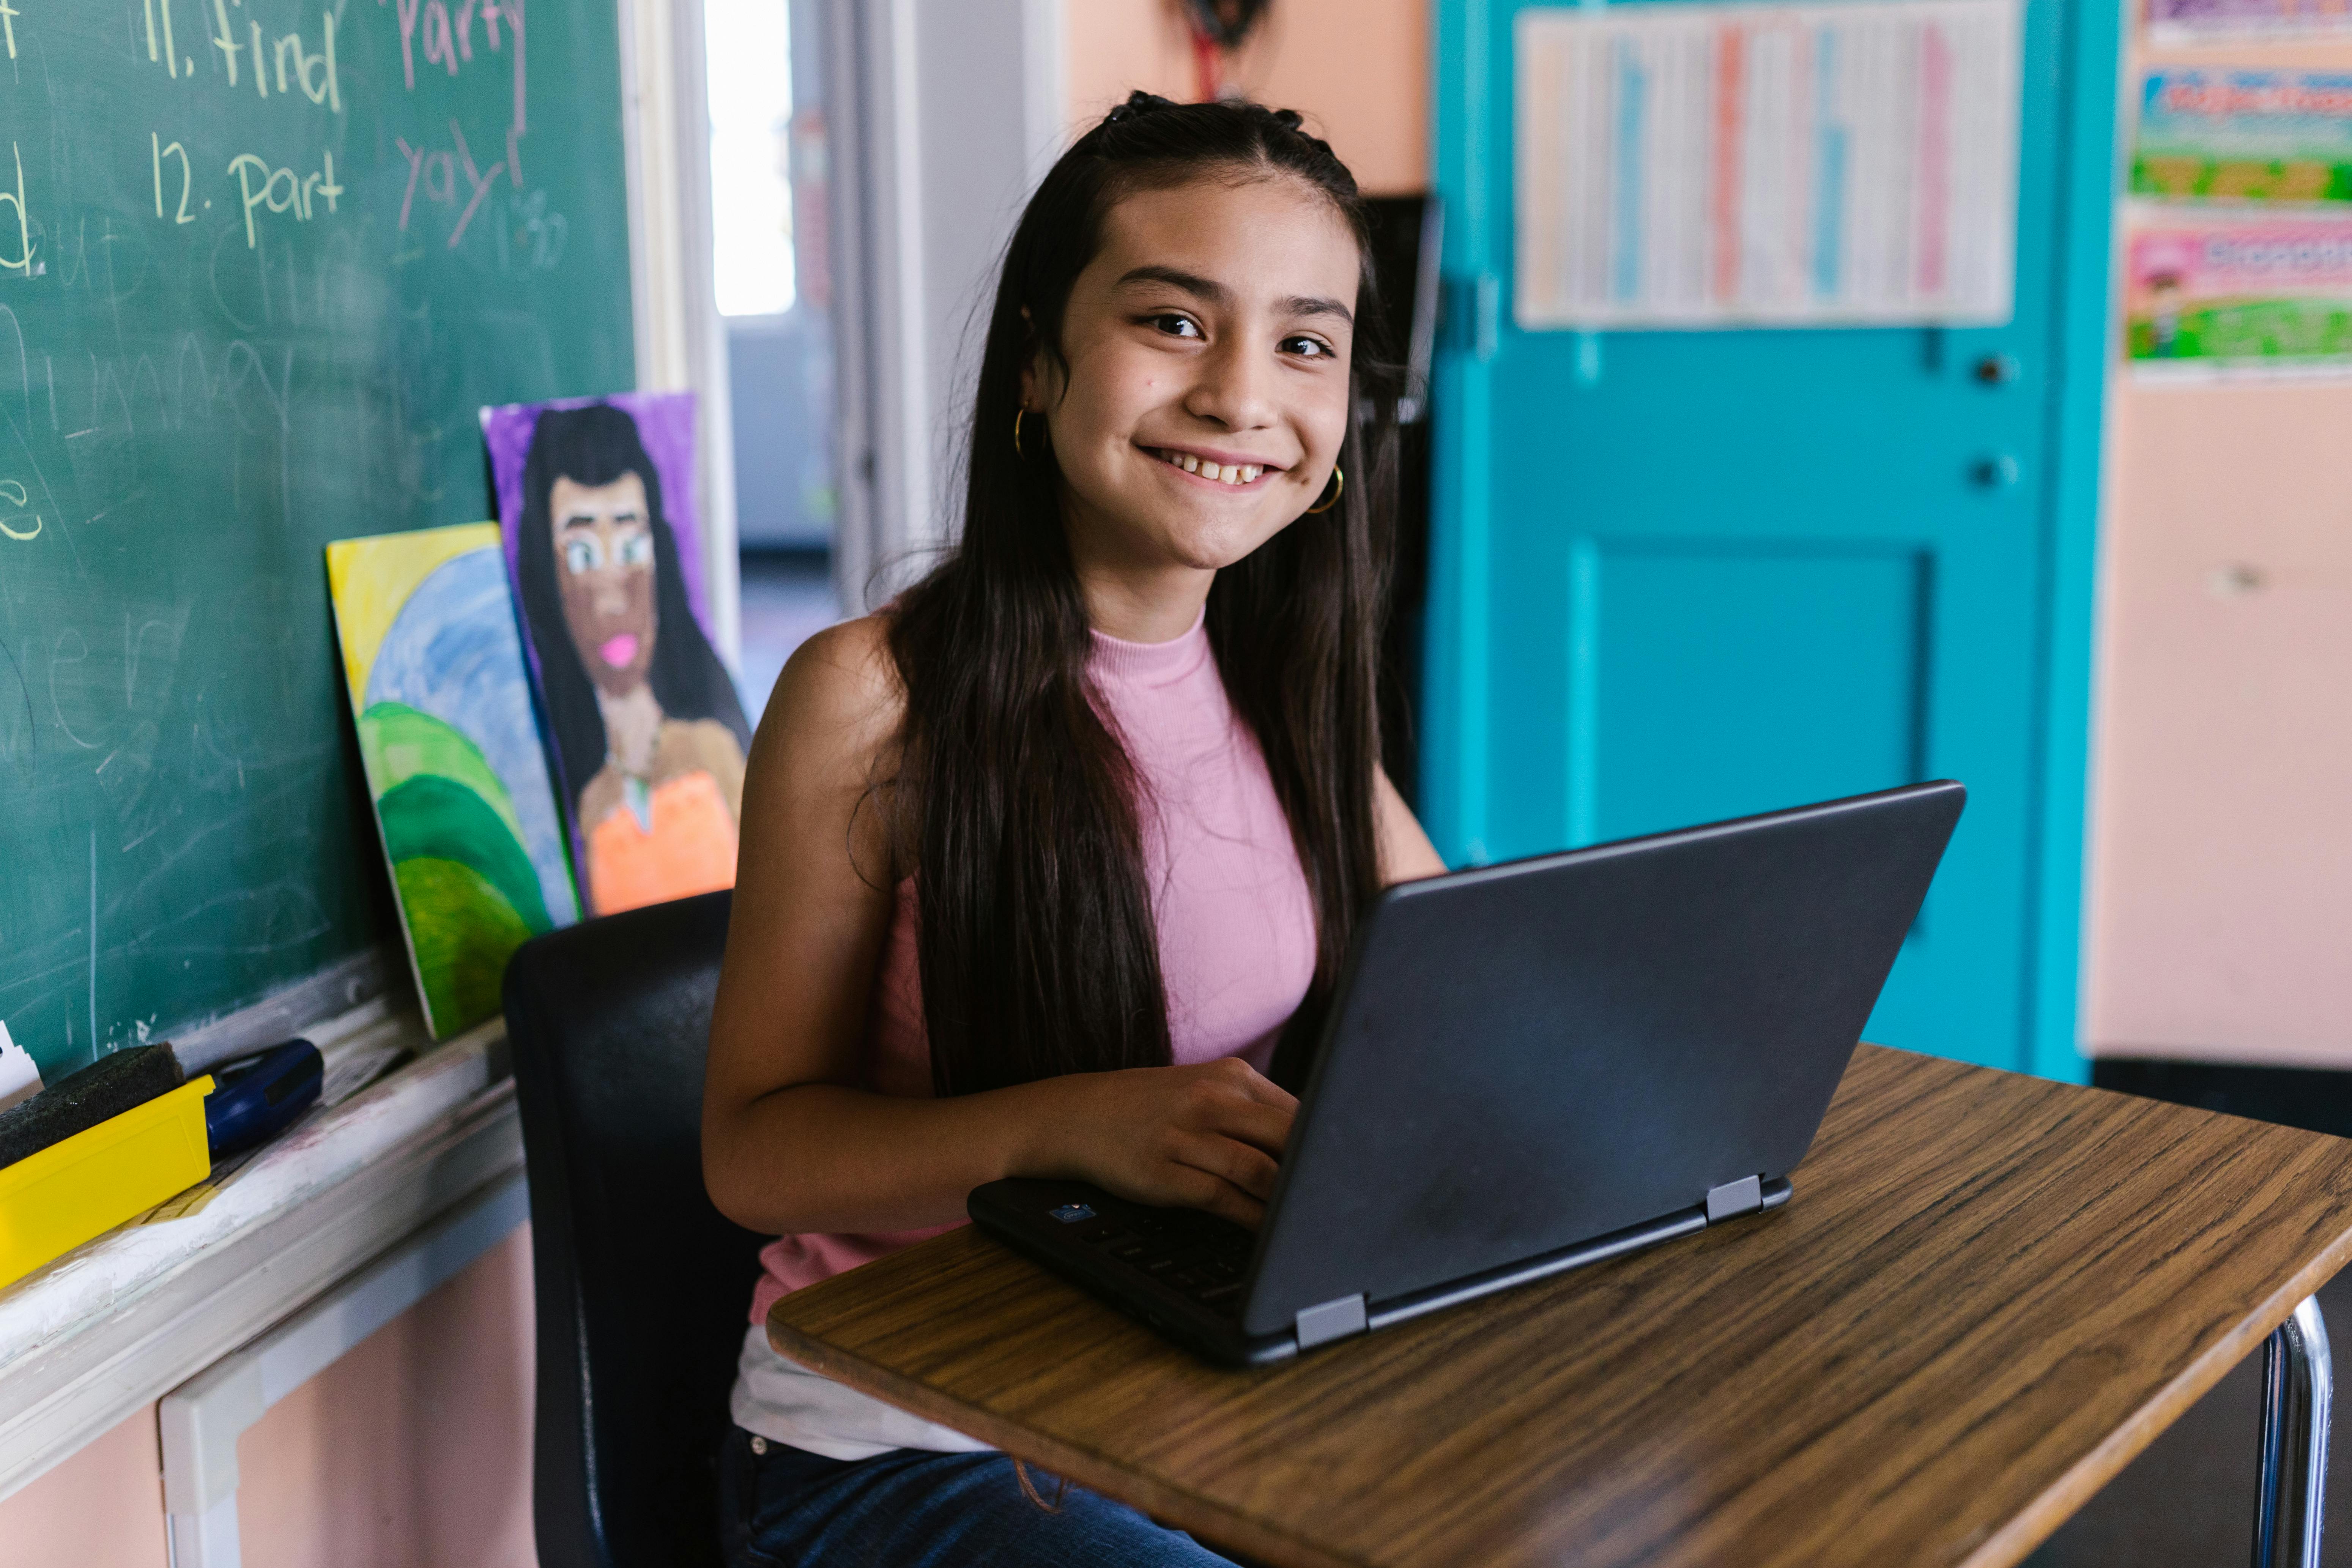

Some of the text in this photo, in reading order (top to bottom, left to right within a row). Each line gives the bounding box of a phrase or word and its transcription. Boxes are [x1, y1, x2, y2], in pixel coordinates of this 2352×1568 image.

[213, 0, 341, 113] find
[152, 131, 344, 249] 12. part
